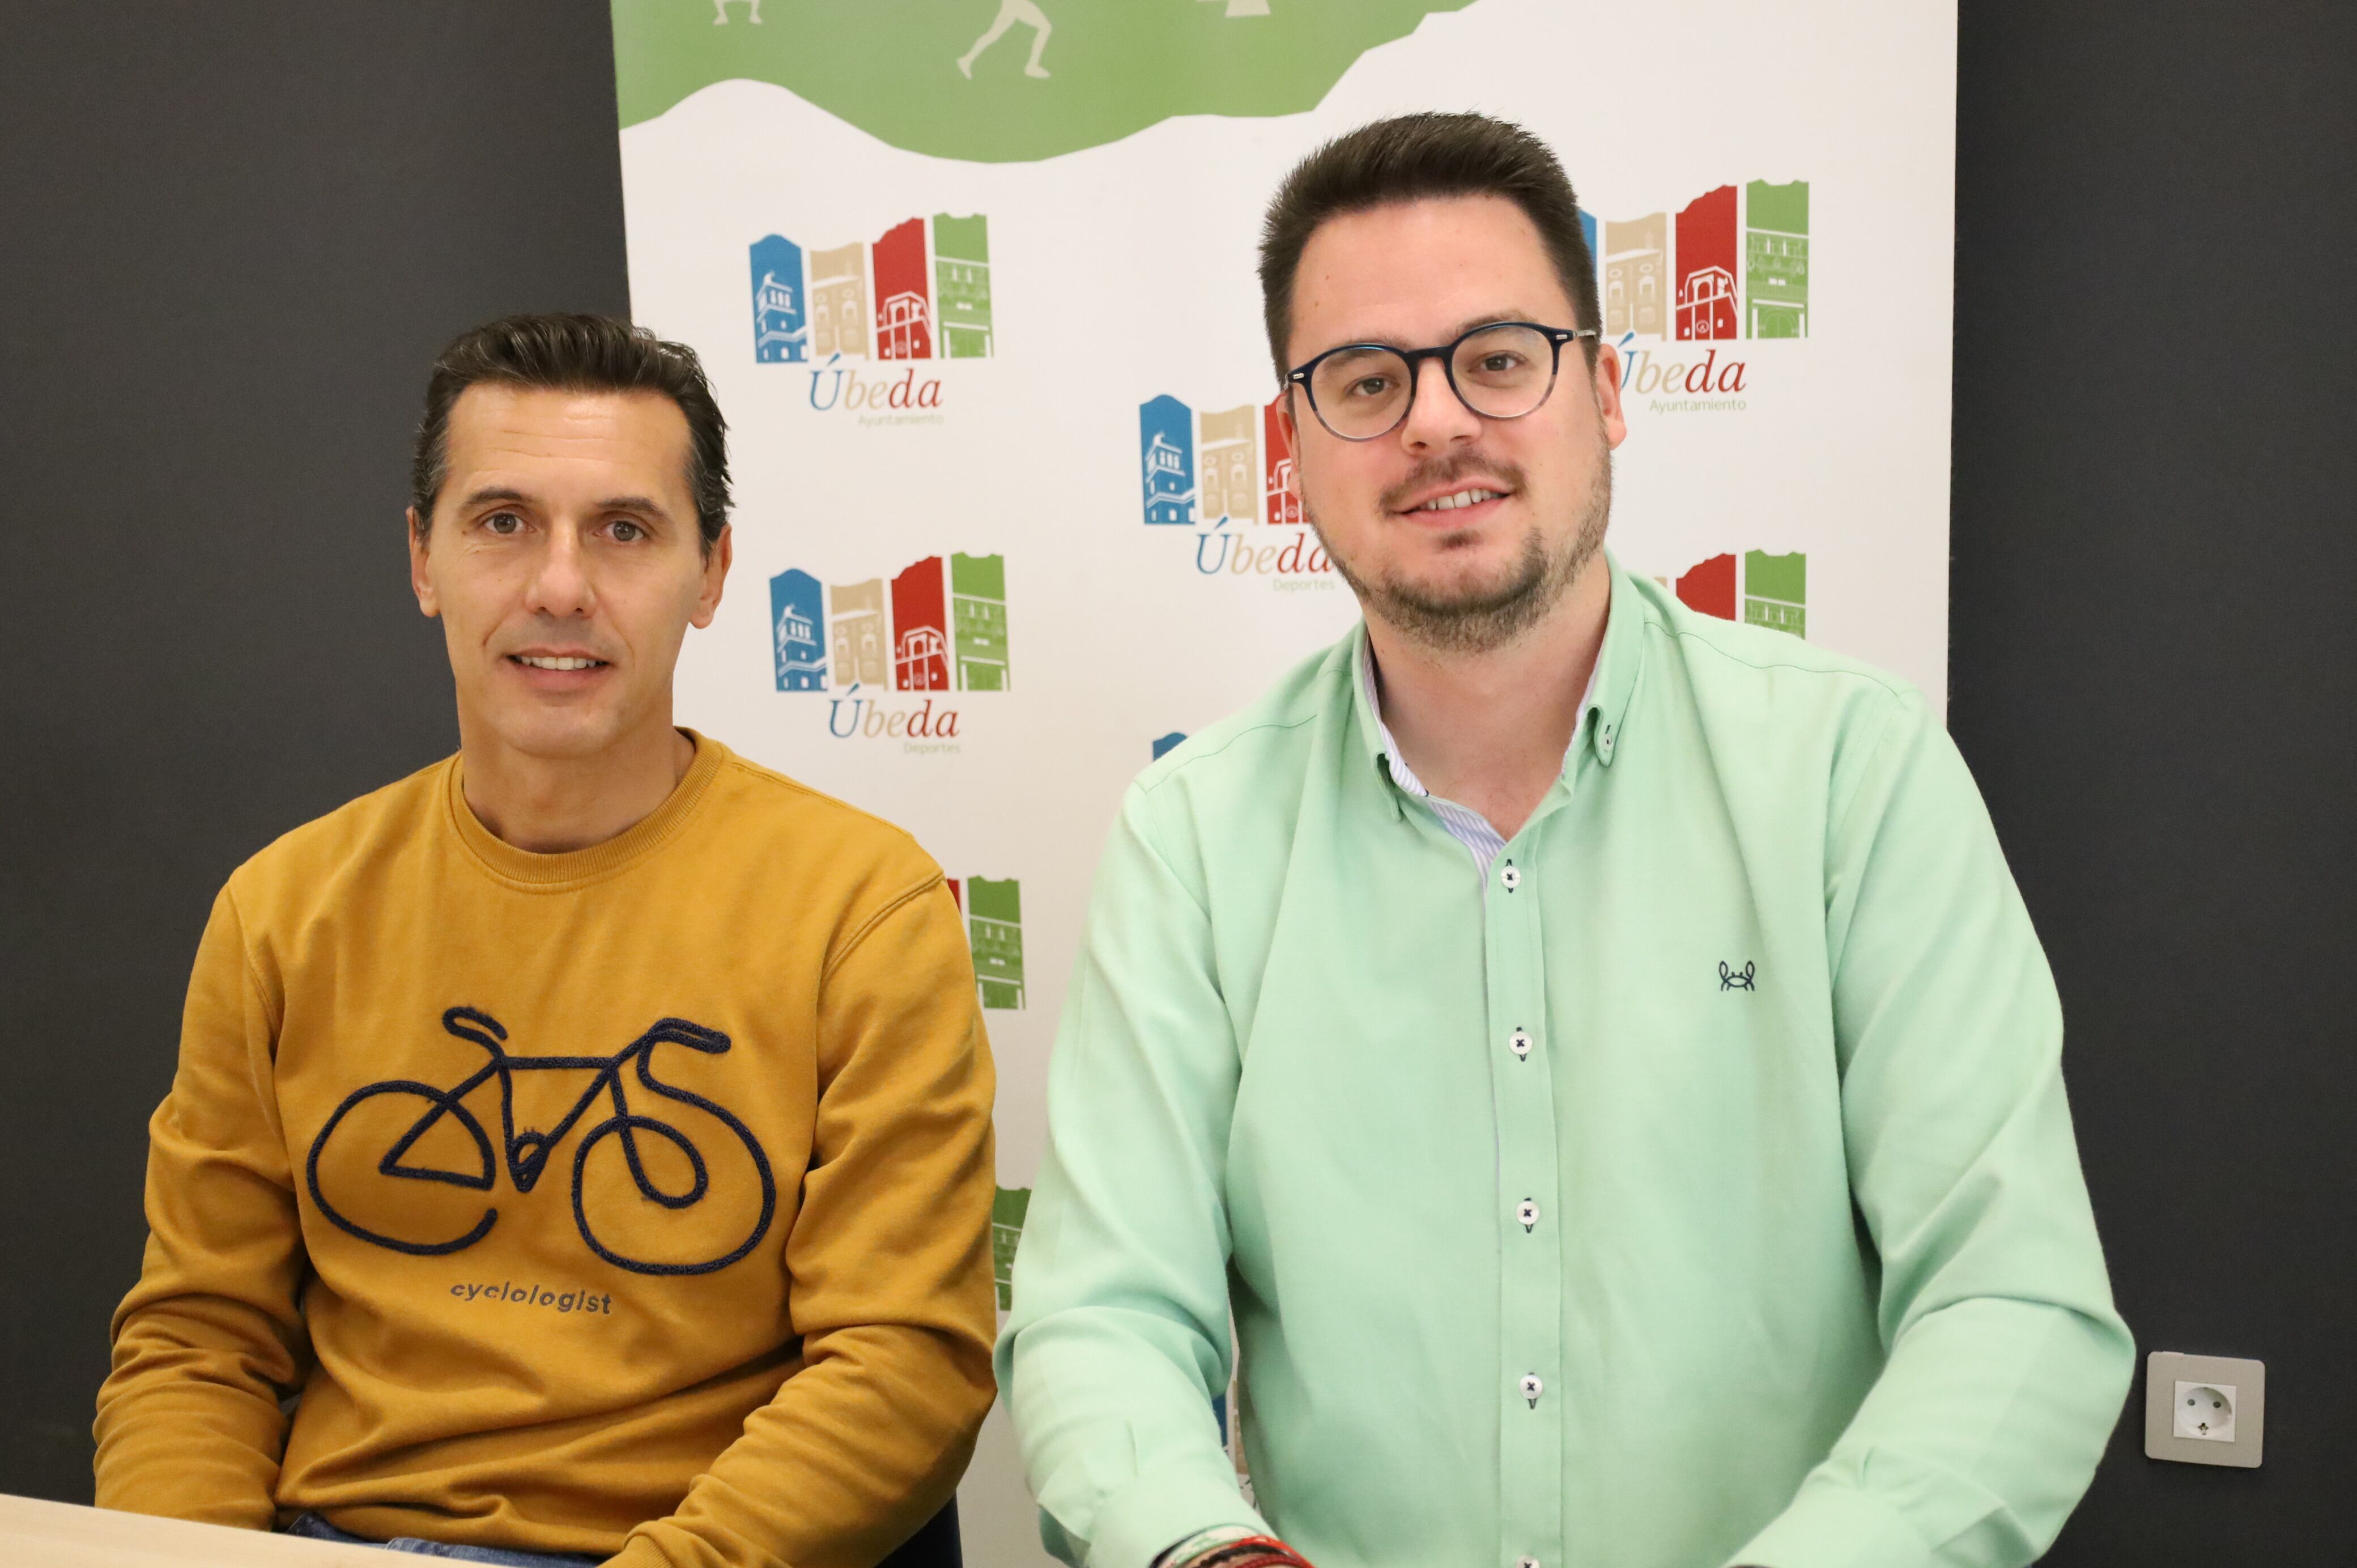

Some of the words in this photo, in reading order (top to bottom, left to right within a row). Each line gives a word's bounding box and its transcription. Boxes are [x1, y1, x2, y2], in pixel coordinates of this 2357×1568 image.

[810, 353, 943, 410] Úbeda
[1649, 398, 1747, 415] Ayuntamiento
[857, 415, 944, 427] Ayuntamiento
[1196, 516, 1334, 574] Úbeda
[1273, 579, 1335, 592] Deportes
[829, 683, 961, 738] Úbeda
[904, 743, 961, 755] Deportes
[450, 1281, 611, 1315] cyclologist
